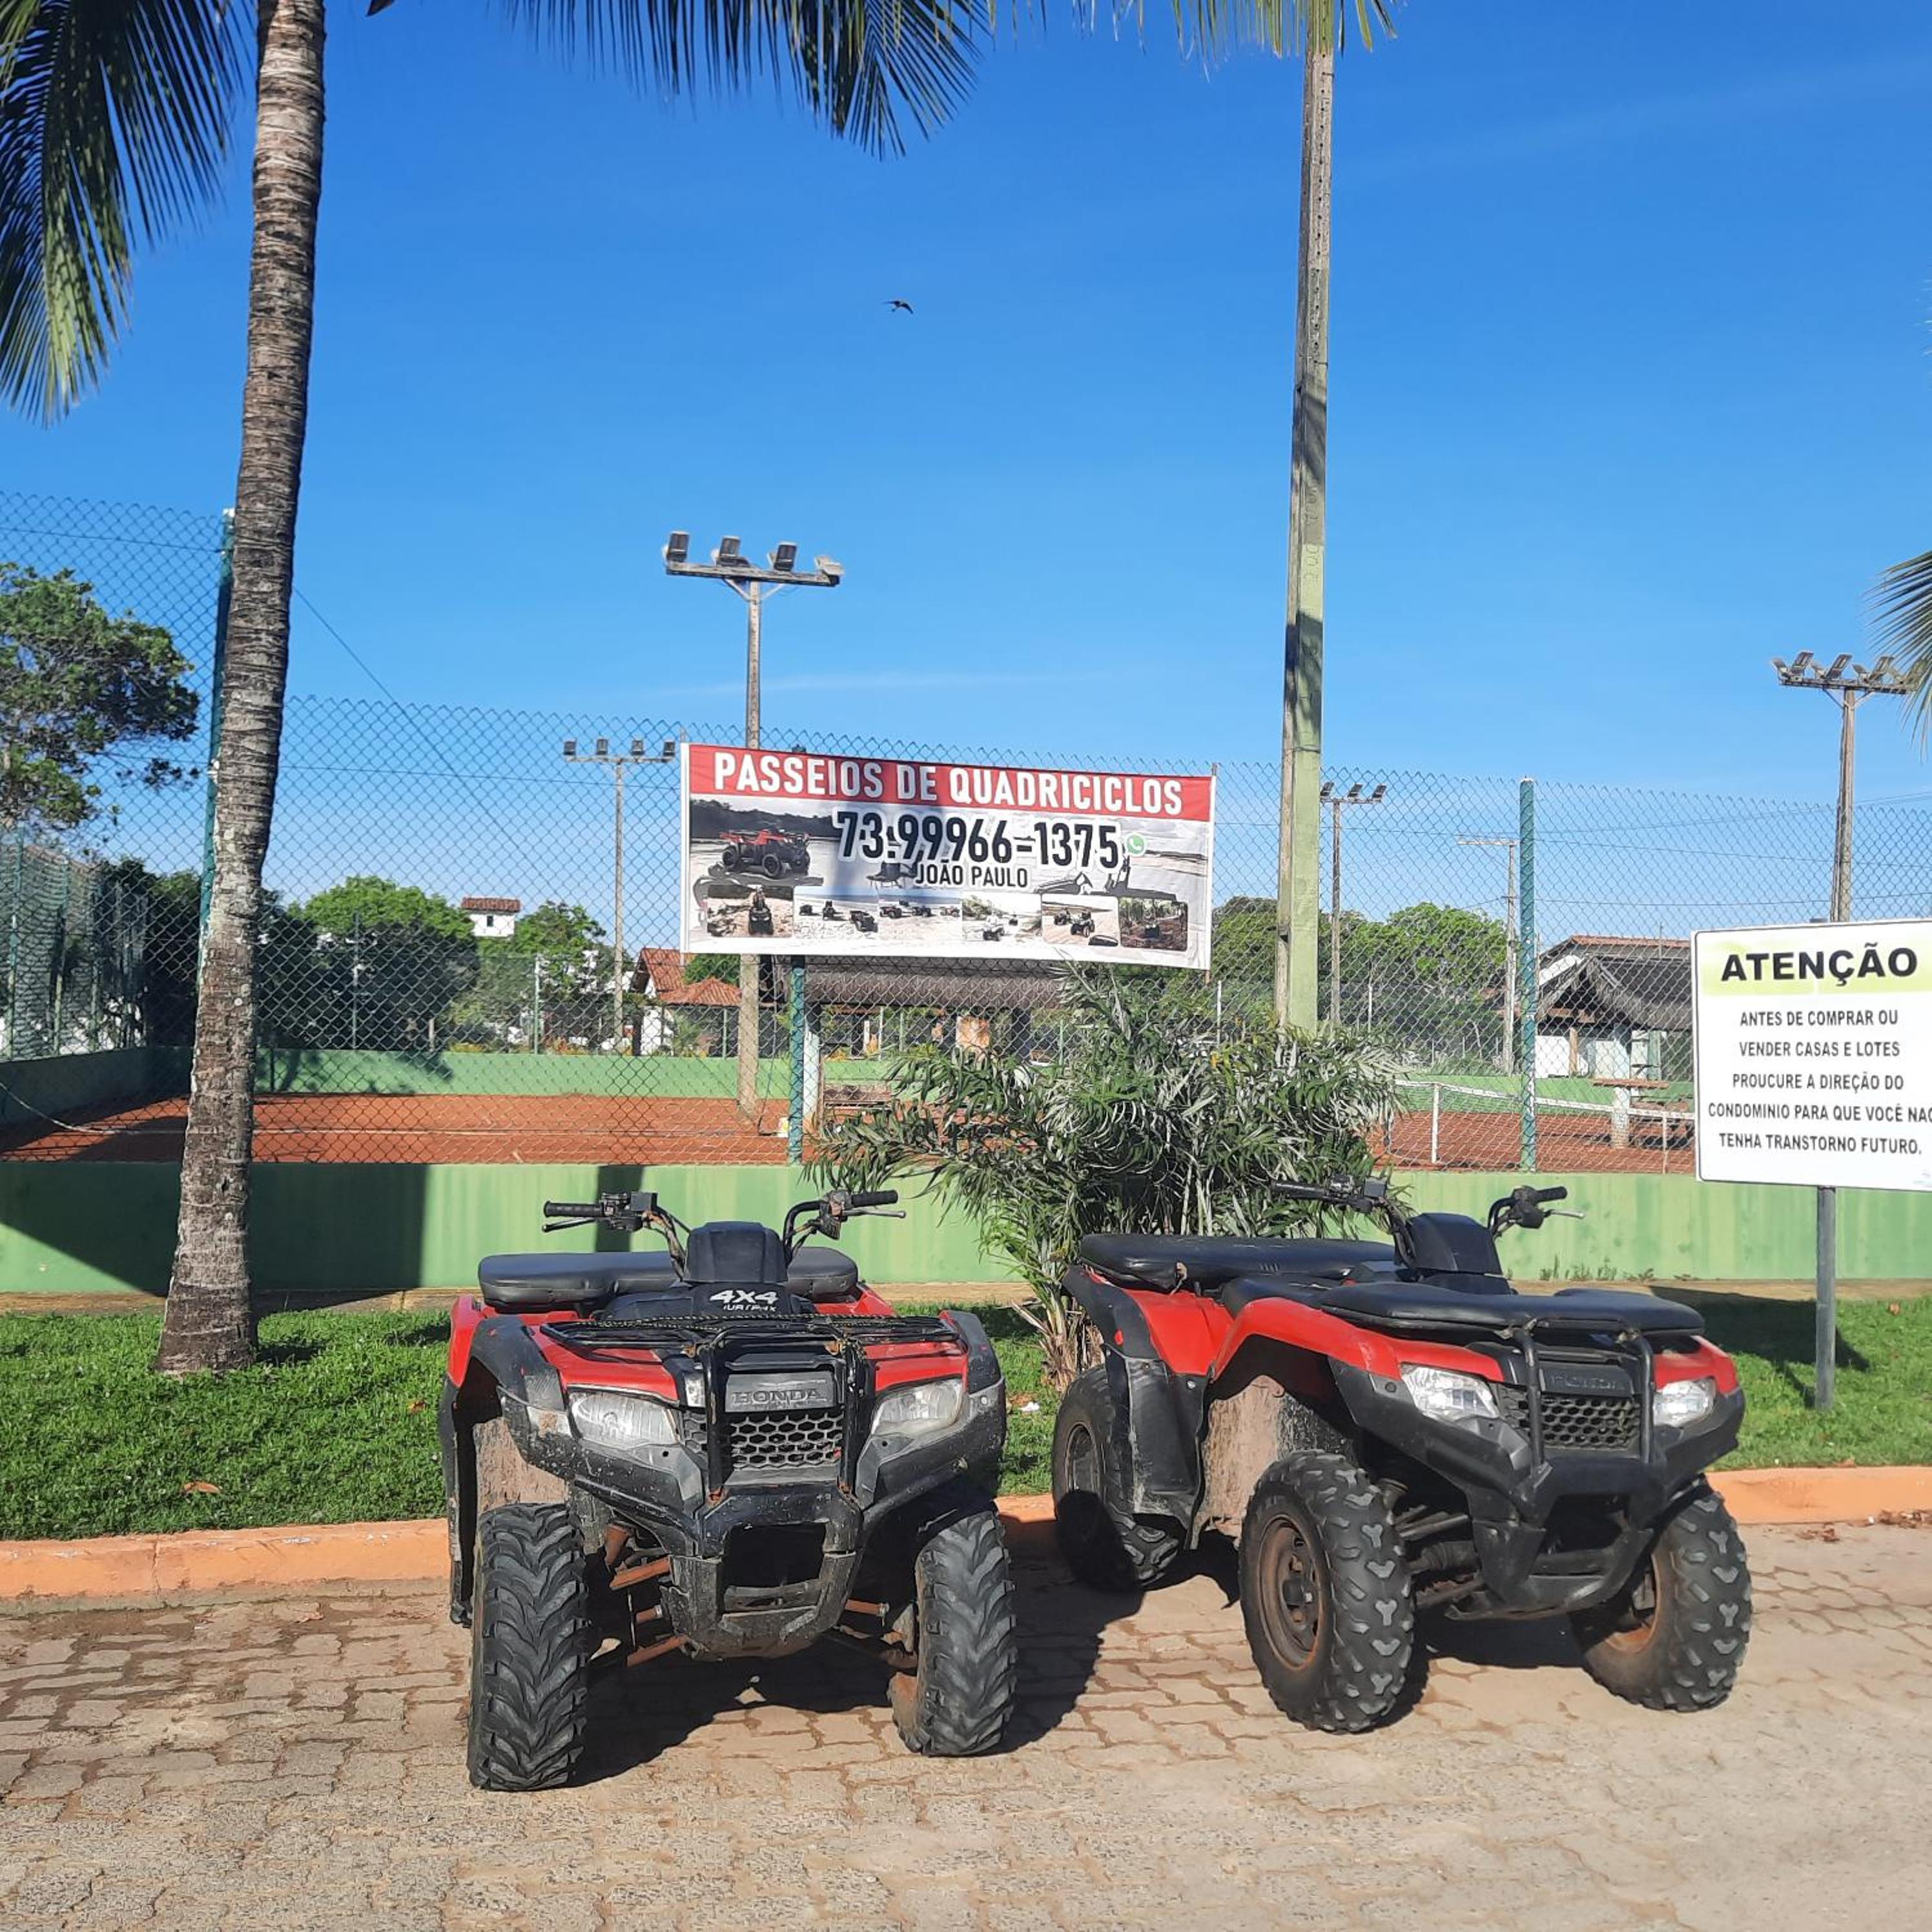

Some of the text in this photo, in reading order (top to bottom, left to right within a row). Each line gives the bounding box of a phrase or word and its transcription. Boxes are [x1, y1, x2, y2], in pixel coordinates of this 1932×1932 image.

[714, 752, 1182, 816] PASSEIOS DE QUADRICICLOS
[915, 858, 1028, 888] JOÃO PAULO
[1721, 941, 1918, 987] ATENÇÃO
[1740, 1009, 1898, 1026] ANTES DE COMPRAR OU
[1740, 1041, 1900, 1057] VENDER CASAS E LOTES
[1732, 1072, 1904, 1094] PROUCURE A DIREÇÃO DO
[1795, 1104, 1829, 1120] PARA
[1833, 1105, 1861, 1122] QUE
[1719, 1133, 1922, 1155] TENHA TRANSTORNO FUTURO.
[732, 1388, 827, 1405] HONDA
